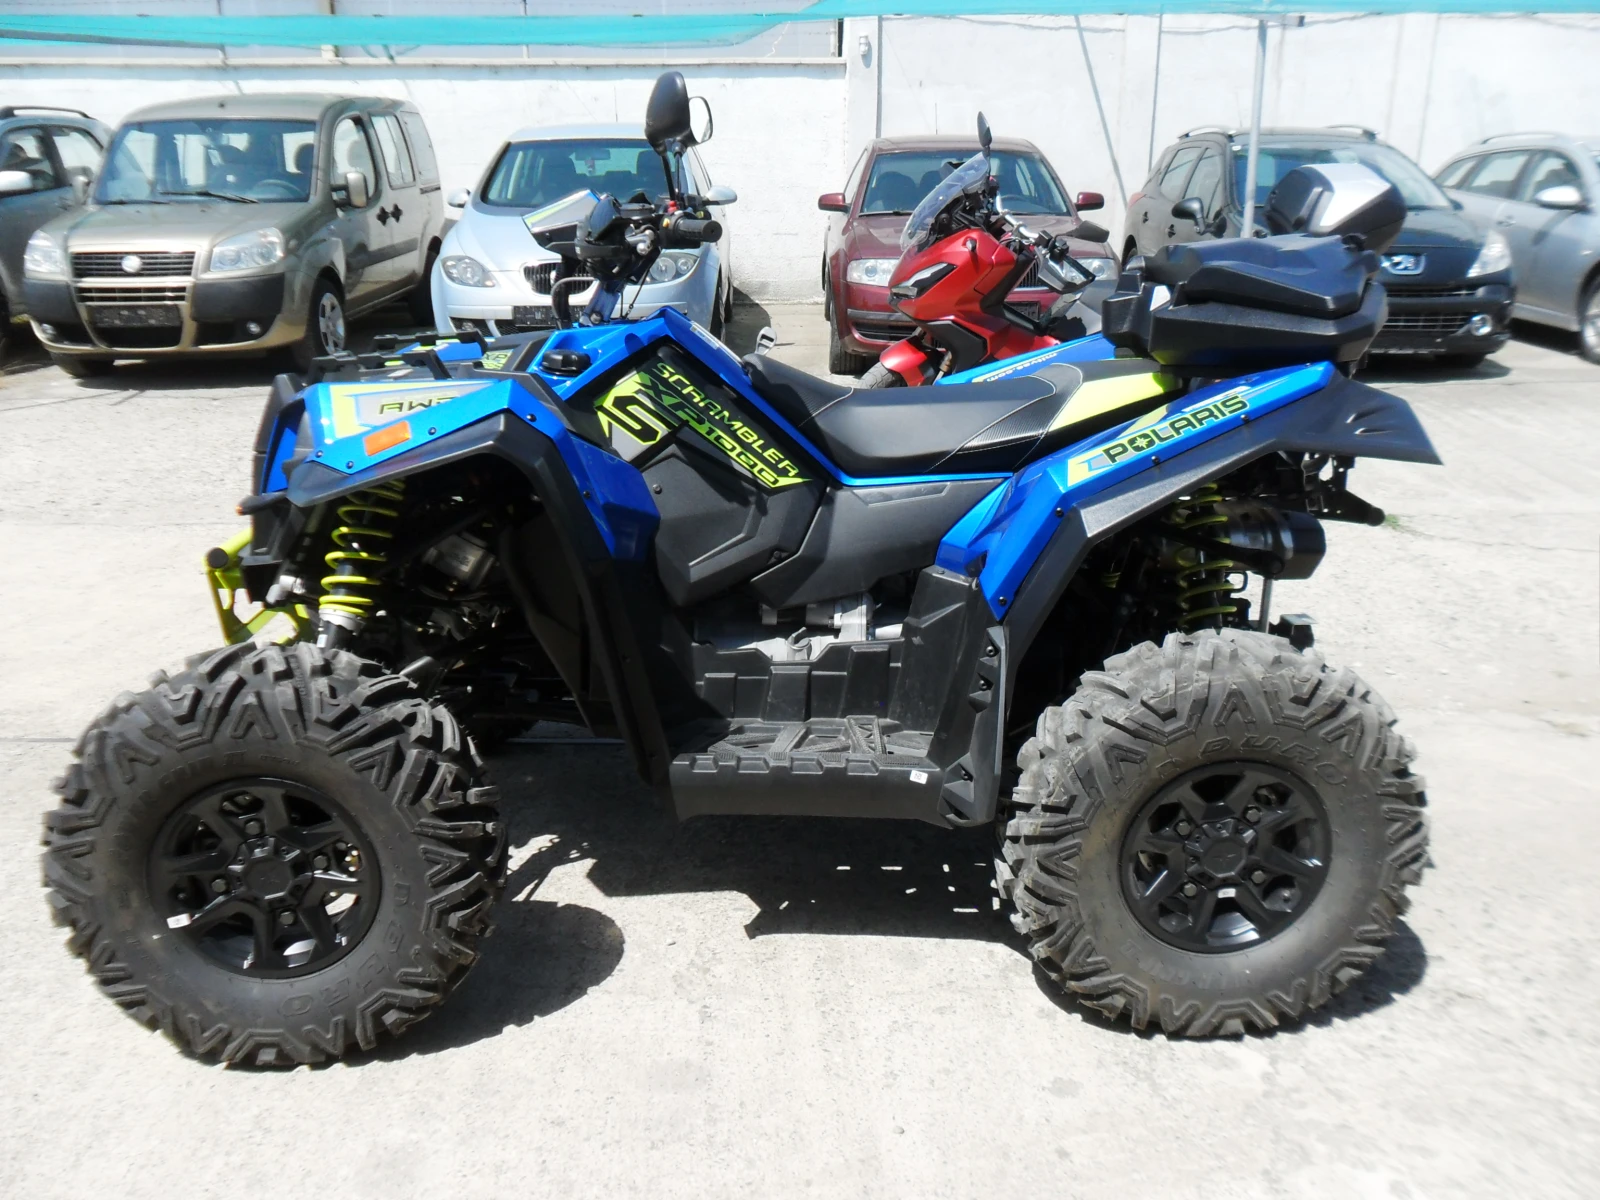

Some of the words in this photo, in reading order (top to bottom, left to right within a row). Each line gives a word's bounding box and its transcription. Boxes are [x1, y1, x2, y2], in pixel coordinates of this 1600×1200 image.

[651, 362, 800, 477] SCRAMBLER
[1102, 395, 1249, 464] POLARIS
[1199, 734, 1348, 786] DURO
